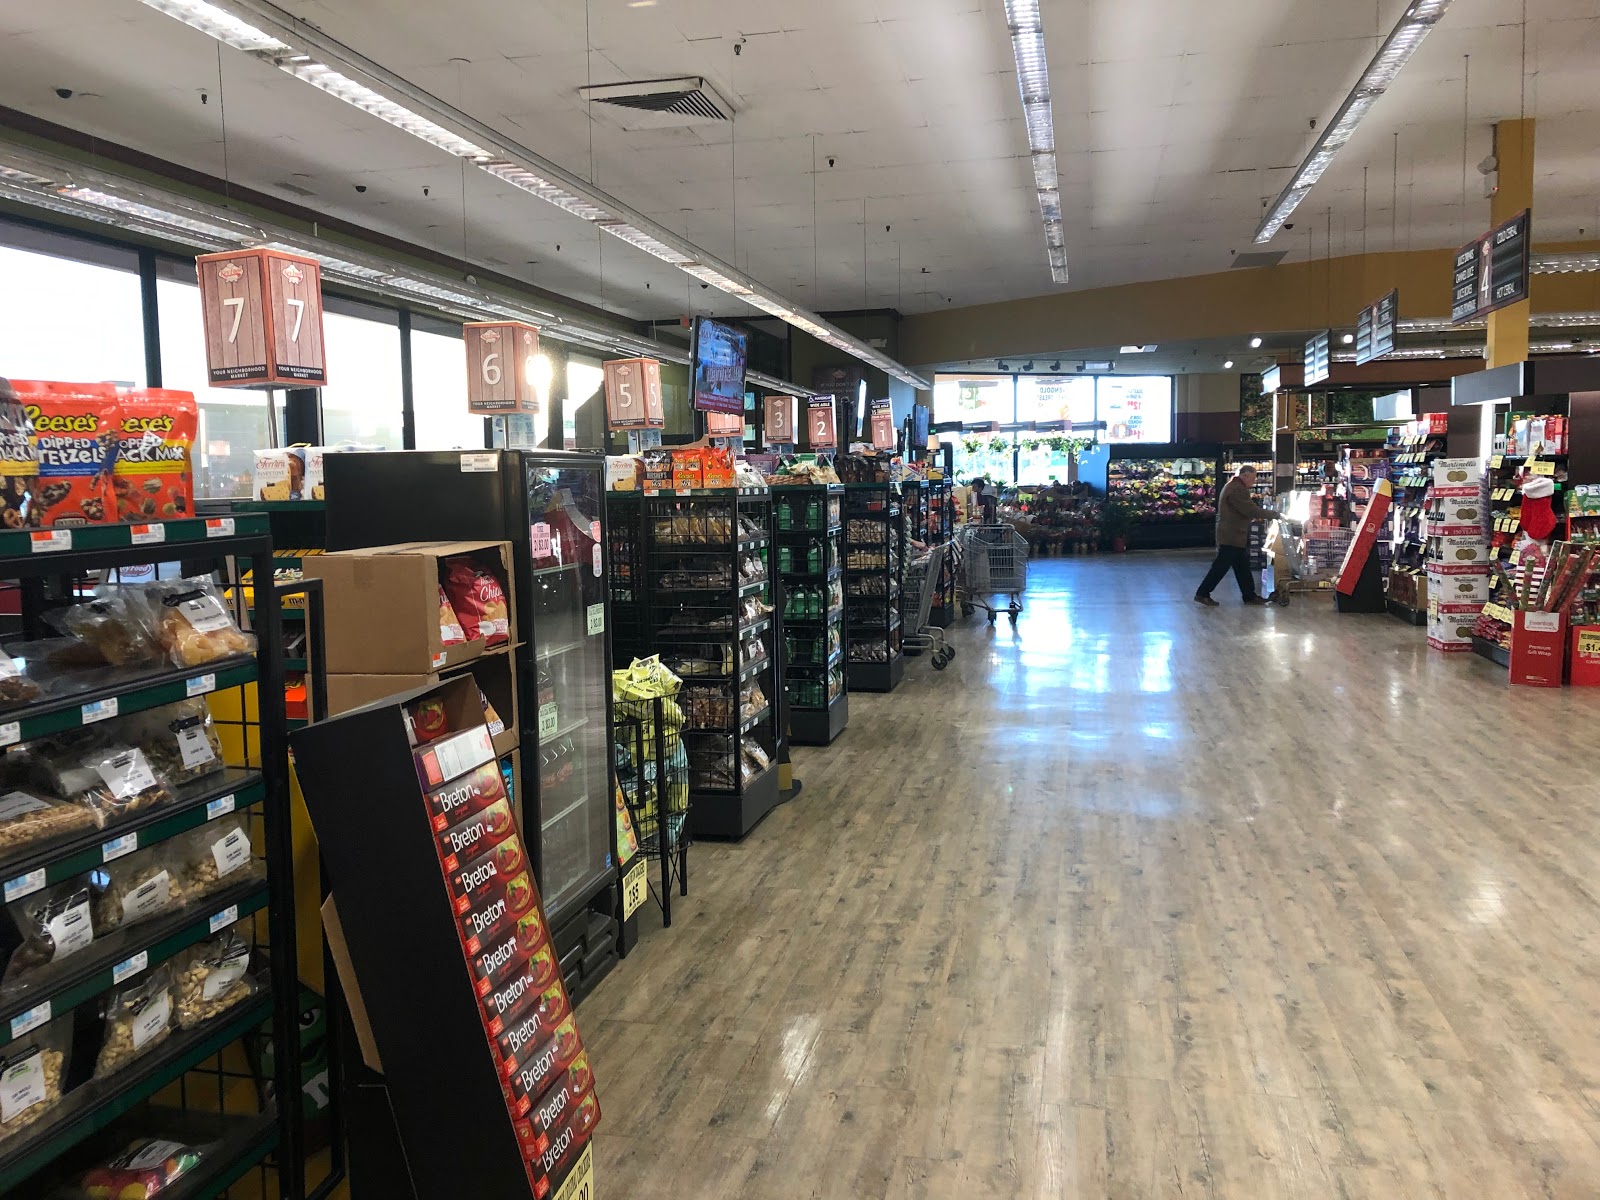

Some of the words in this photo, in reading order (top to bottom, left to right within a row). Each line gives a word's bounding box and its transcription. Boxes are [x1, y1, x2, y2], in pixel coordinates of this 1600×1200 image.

[1481, 266, 1489, 298] 4
[224, 297, 245, 344] 7
[286, 298, 304, 344] 7
[482, 353, 500, 385] 6
[620, 383, 632, 408] 5
[650, 382, 657, 407] 5
[774, 411, 784, 428] 3
[816, 421, 826, 436] 2
[880, 430, 885, 442] 1
[439, 784, 475, 812] Breton
[450, 822, 486, 852] Breton
[493, 975, 529, 1014] Breton
[508, 1012, 542, 1054] Breton
[520, 1050, 556, 1093] Breton
[539, 1087, 570, 1131] Breton
[542, 1126, 574, 1173] Breton
